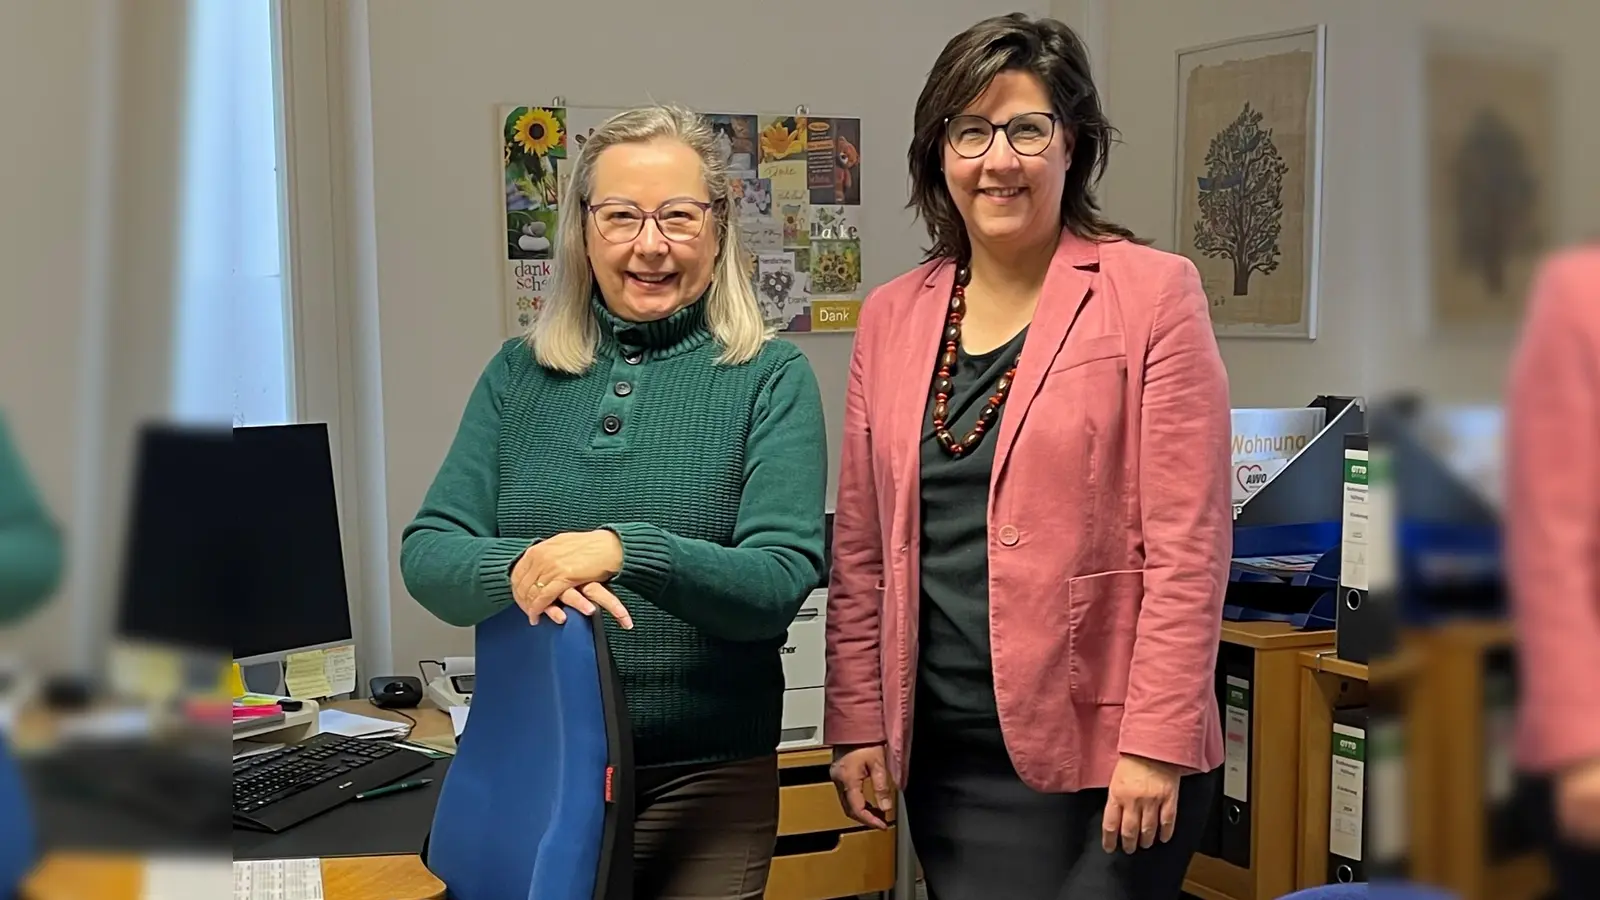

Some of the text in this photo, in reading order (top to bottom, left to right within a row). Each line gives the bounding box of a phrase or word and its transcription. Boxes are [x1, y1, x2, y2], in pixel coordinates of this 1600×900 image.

[514, 260, 551, 277] dank
[819, 307, 850, 322] Dank
[1245, 473, 1267, 484] AWO
[1339, 739, 1357, 750] OTTO
